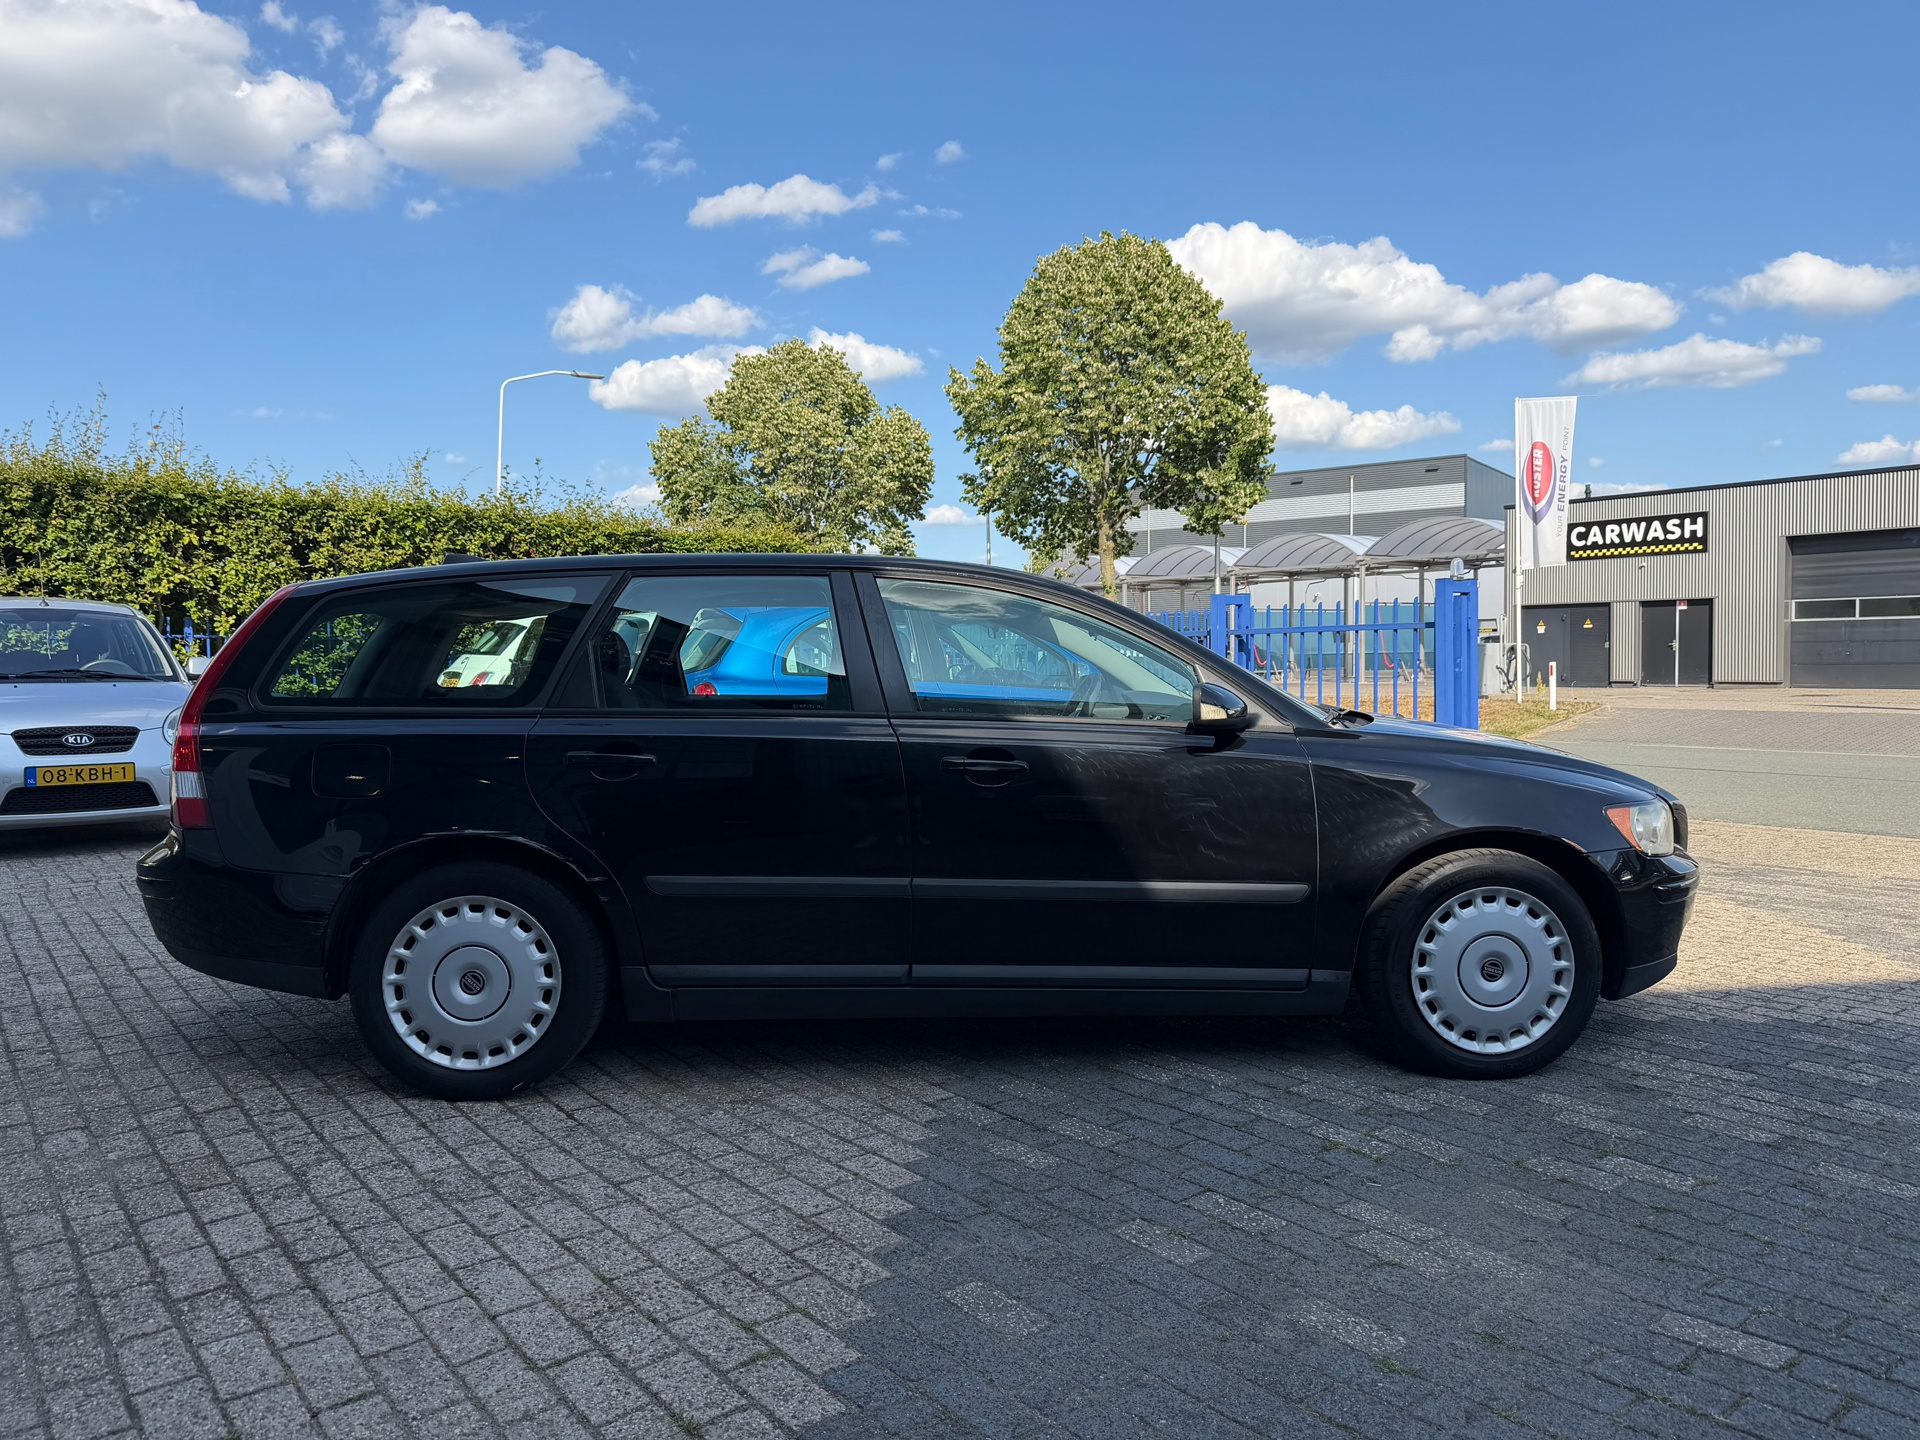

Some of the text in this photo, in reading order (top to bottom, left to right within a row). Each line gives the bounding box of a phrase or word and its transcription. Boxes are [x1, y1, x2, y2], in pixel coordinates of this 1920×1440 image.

[1557, 455, 1568, 512] ENERGY
[1570, 516, 1704, 547] CARWASH
[67, 736, 90, 744] KIA
[1483, 966, 1503, 976] VOLVO
[464, 975, 480, 990] VOLVO
